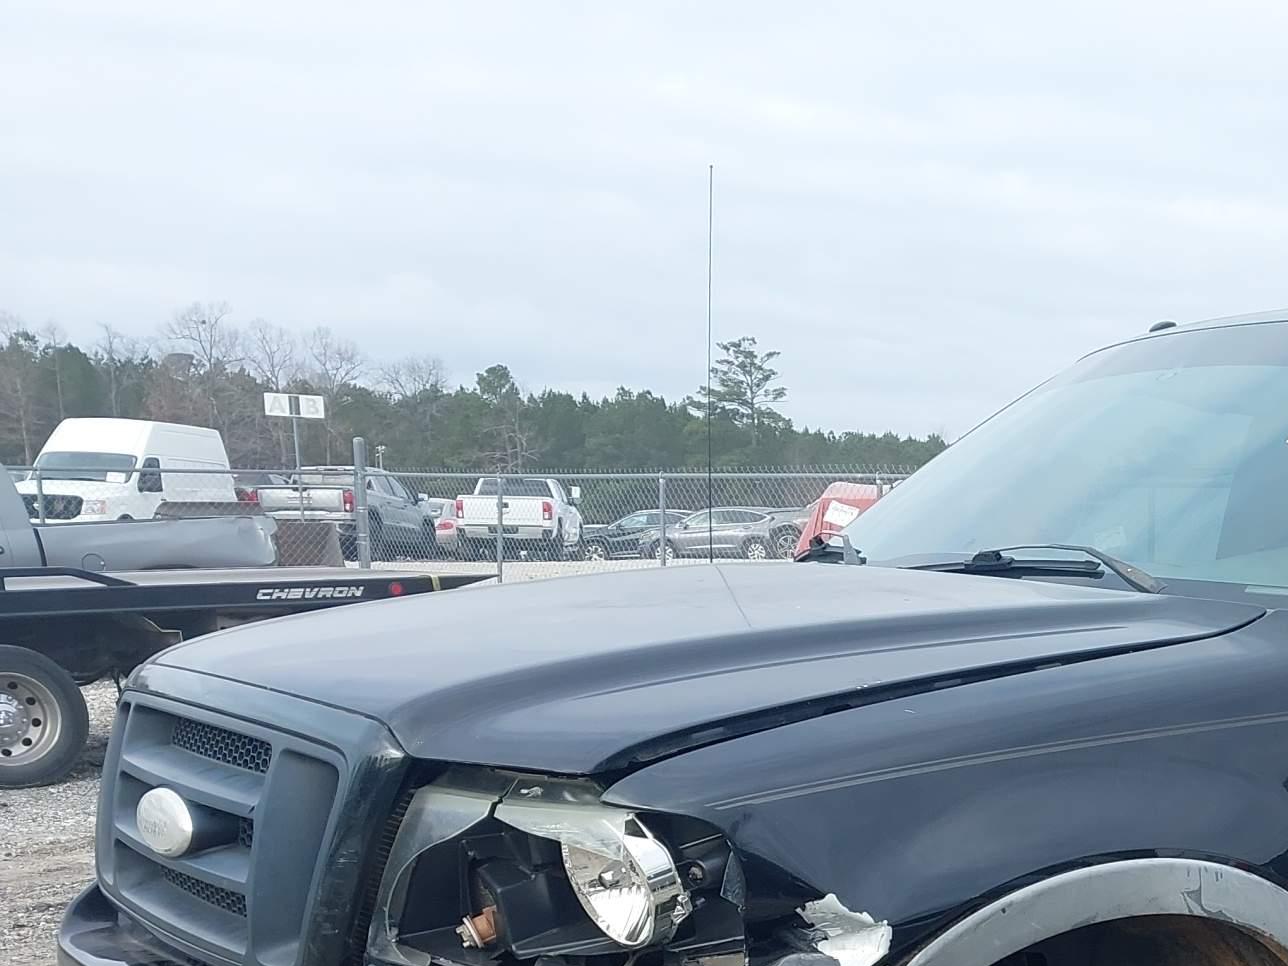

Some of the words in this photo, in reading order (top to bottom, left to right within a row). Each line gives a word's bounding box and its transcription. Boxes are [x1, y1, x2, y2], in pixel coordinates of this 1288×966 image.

[269, 396, 287, 413] A
[305, 398, 320, 415] B
[256, 586, 365, 600] CHEVRON
